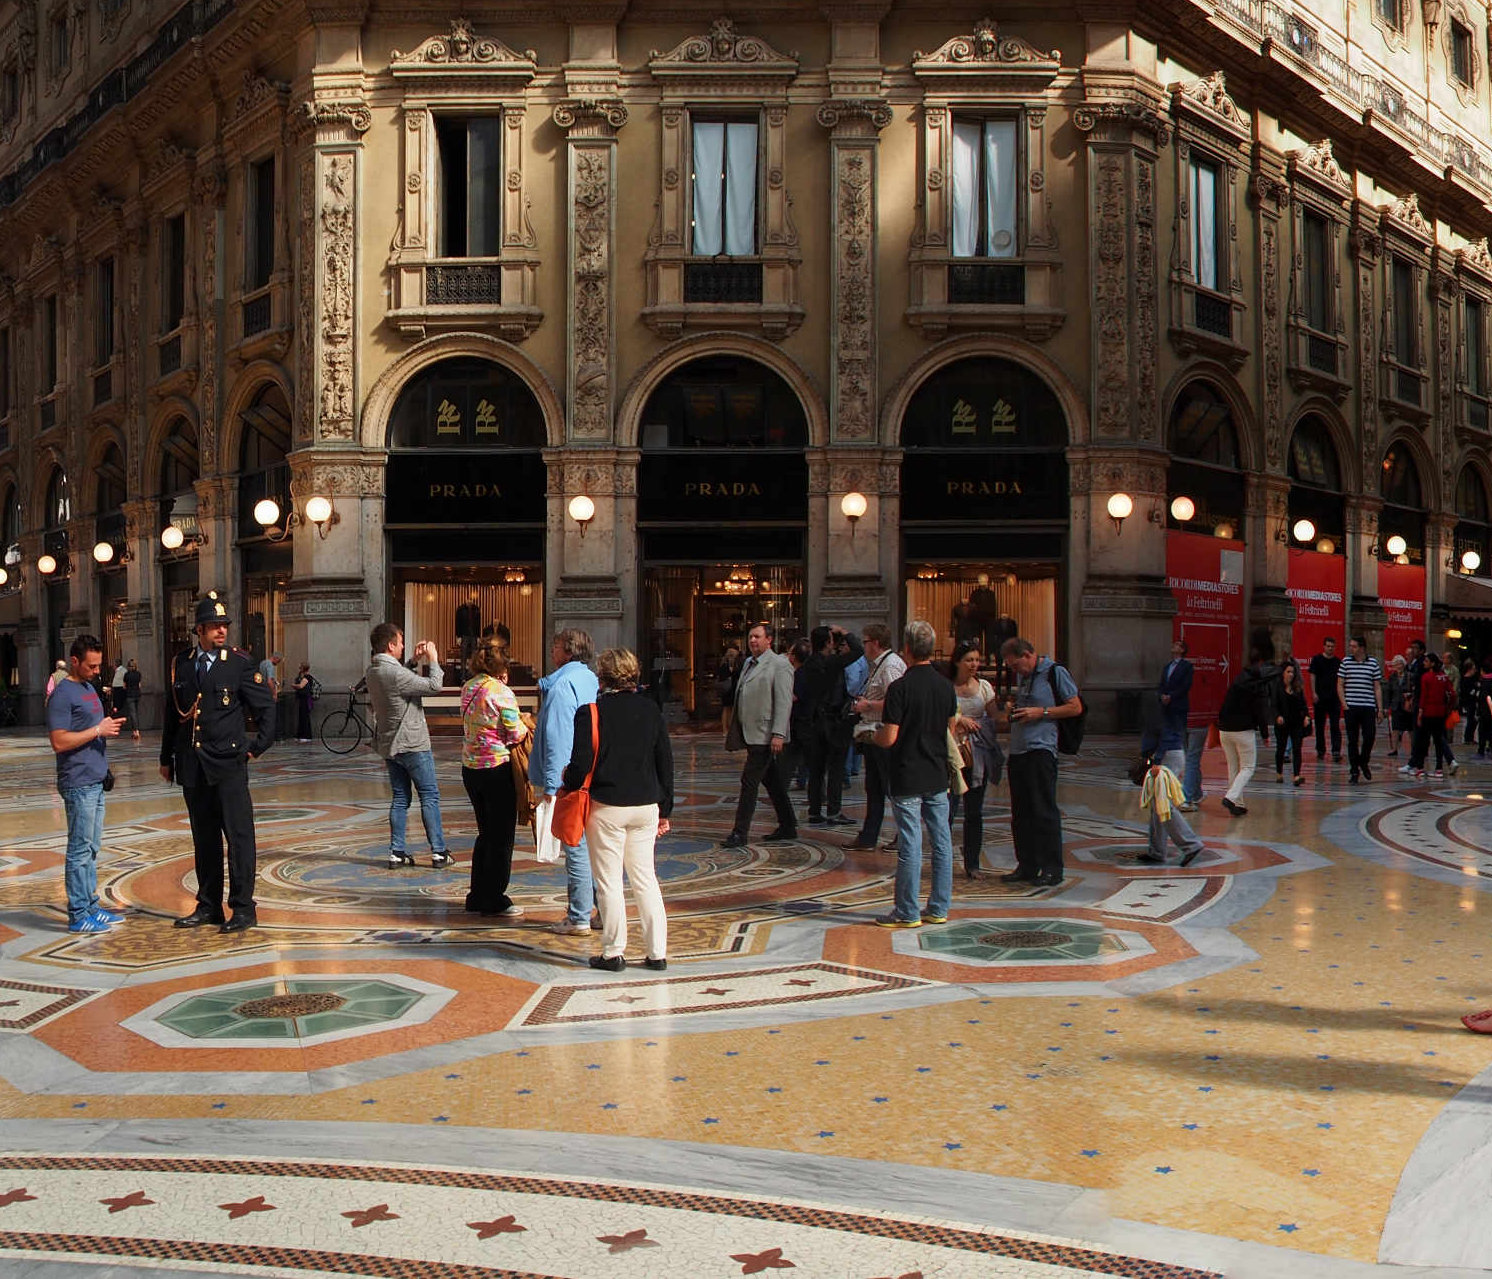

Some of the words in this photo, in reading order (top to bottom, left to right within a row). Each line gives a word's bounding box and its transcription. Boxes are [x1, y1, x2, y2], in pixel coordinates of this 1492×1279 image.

[429, 484, 502, 497] PRADA
[685, 482, 761, 496] PRADA
[946, 481, 1023, 494] PRADA
[1189, 511, 1238, 532] EDIASTORE
[1193, 596, 1223, 610] Feltrinelli
